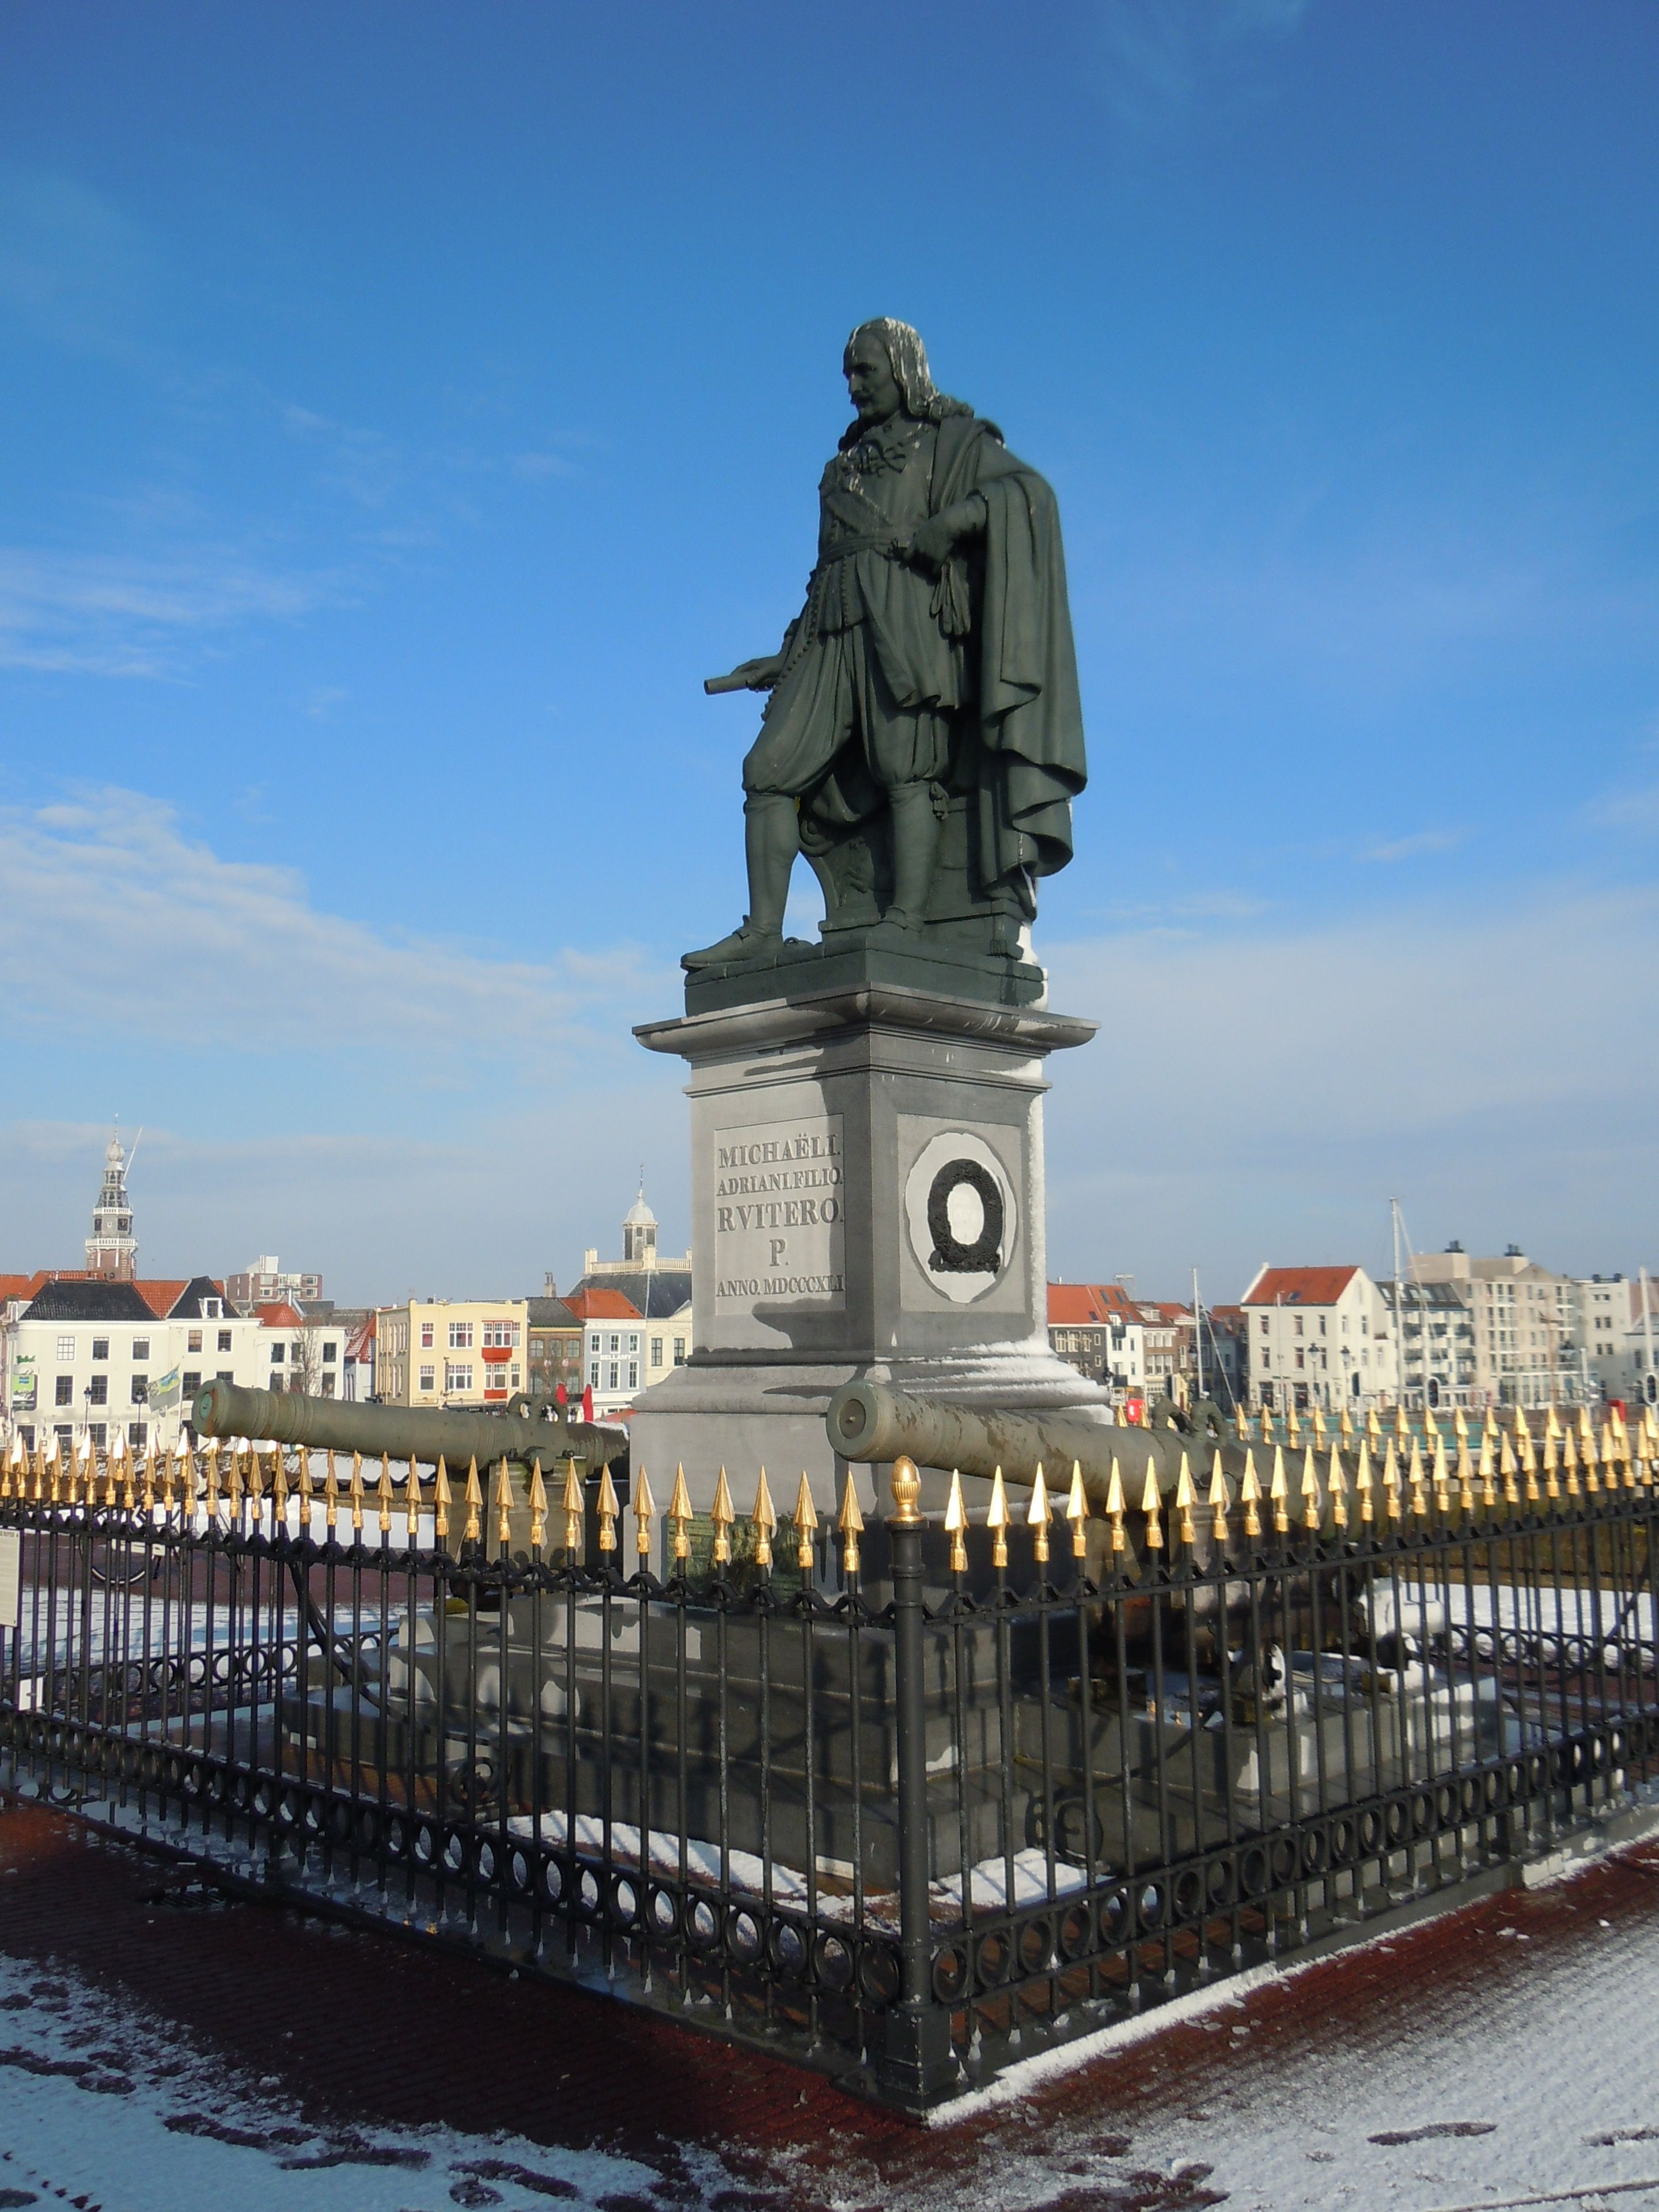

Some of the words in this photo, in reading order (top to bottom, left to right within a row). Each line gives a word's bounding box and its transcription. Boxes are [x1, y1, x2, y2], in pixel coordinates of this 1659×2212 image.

[719, 1132, 841, 1169] MICHAËLI.
[717, 1197, 844, 1232] RVITERO.
[769, 1238, 789, 1267] P.
[716, 1279, 760, 1297] ANNO.
